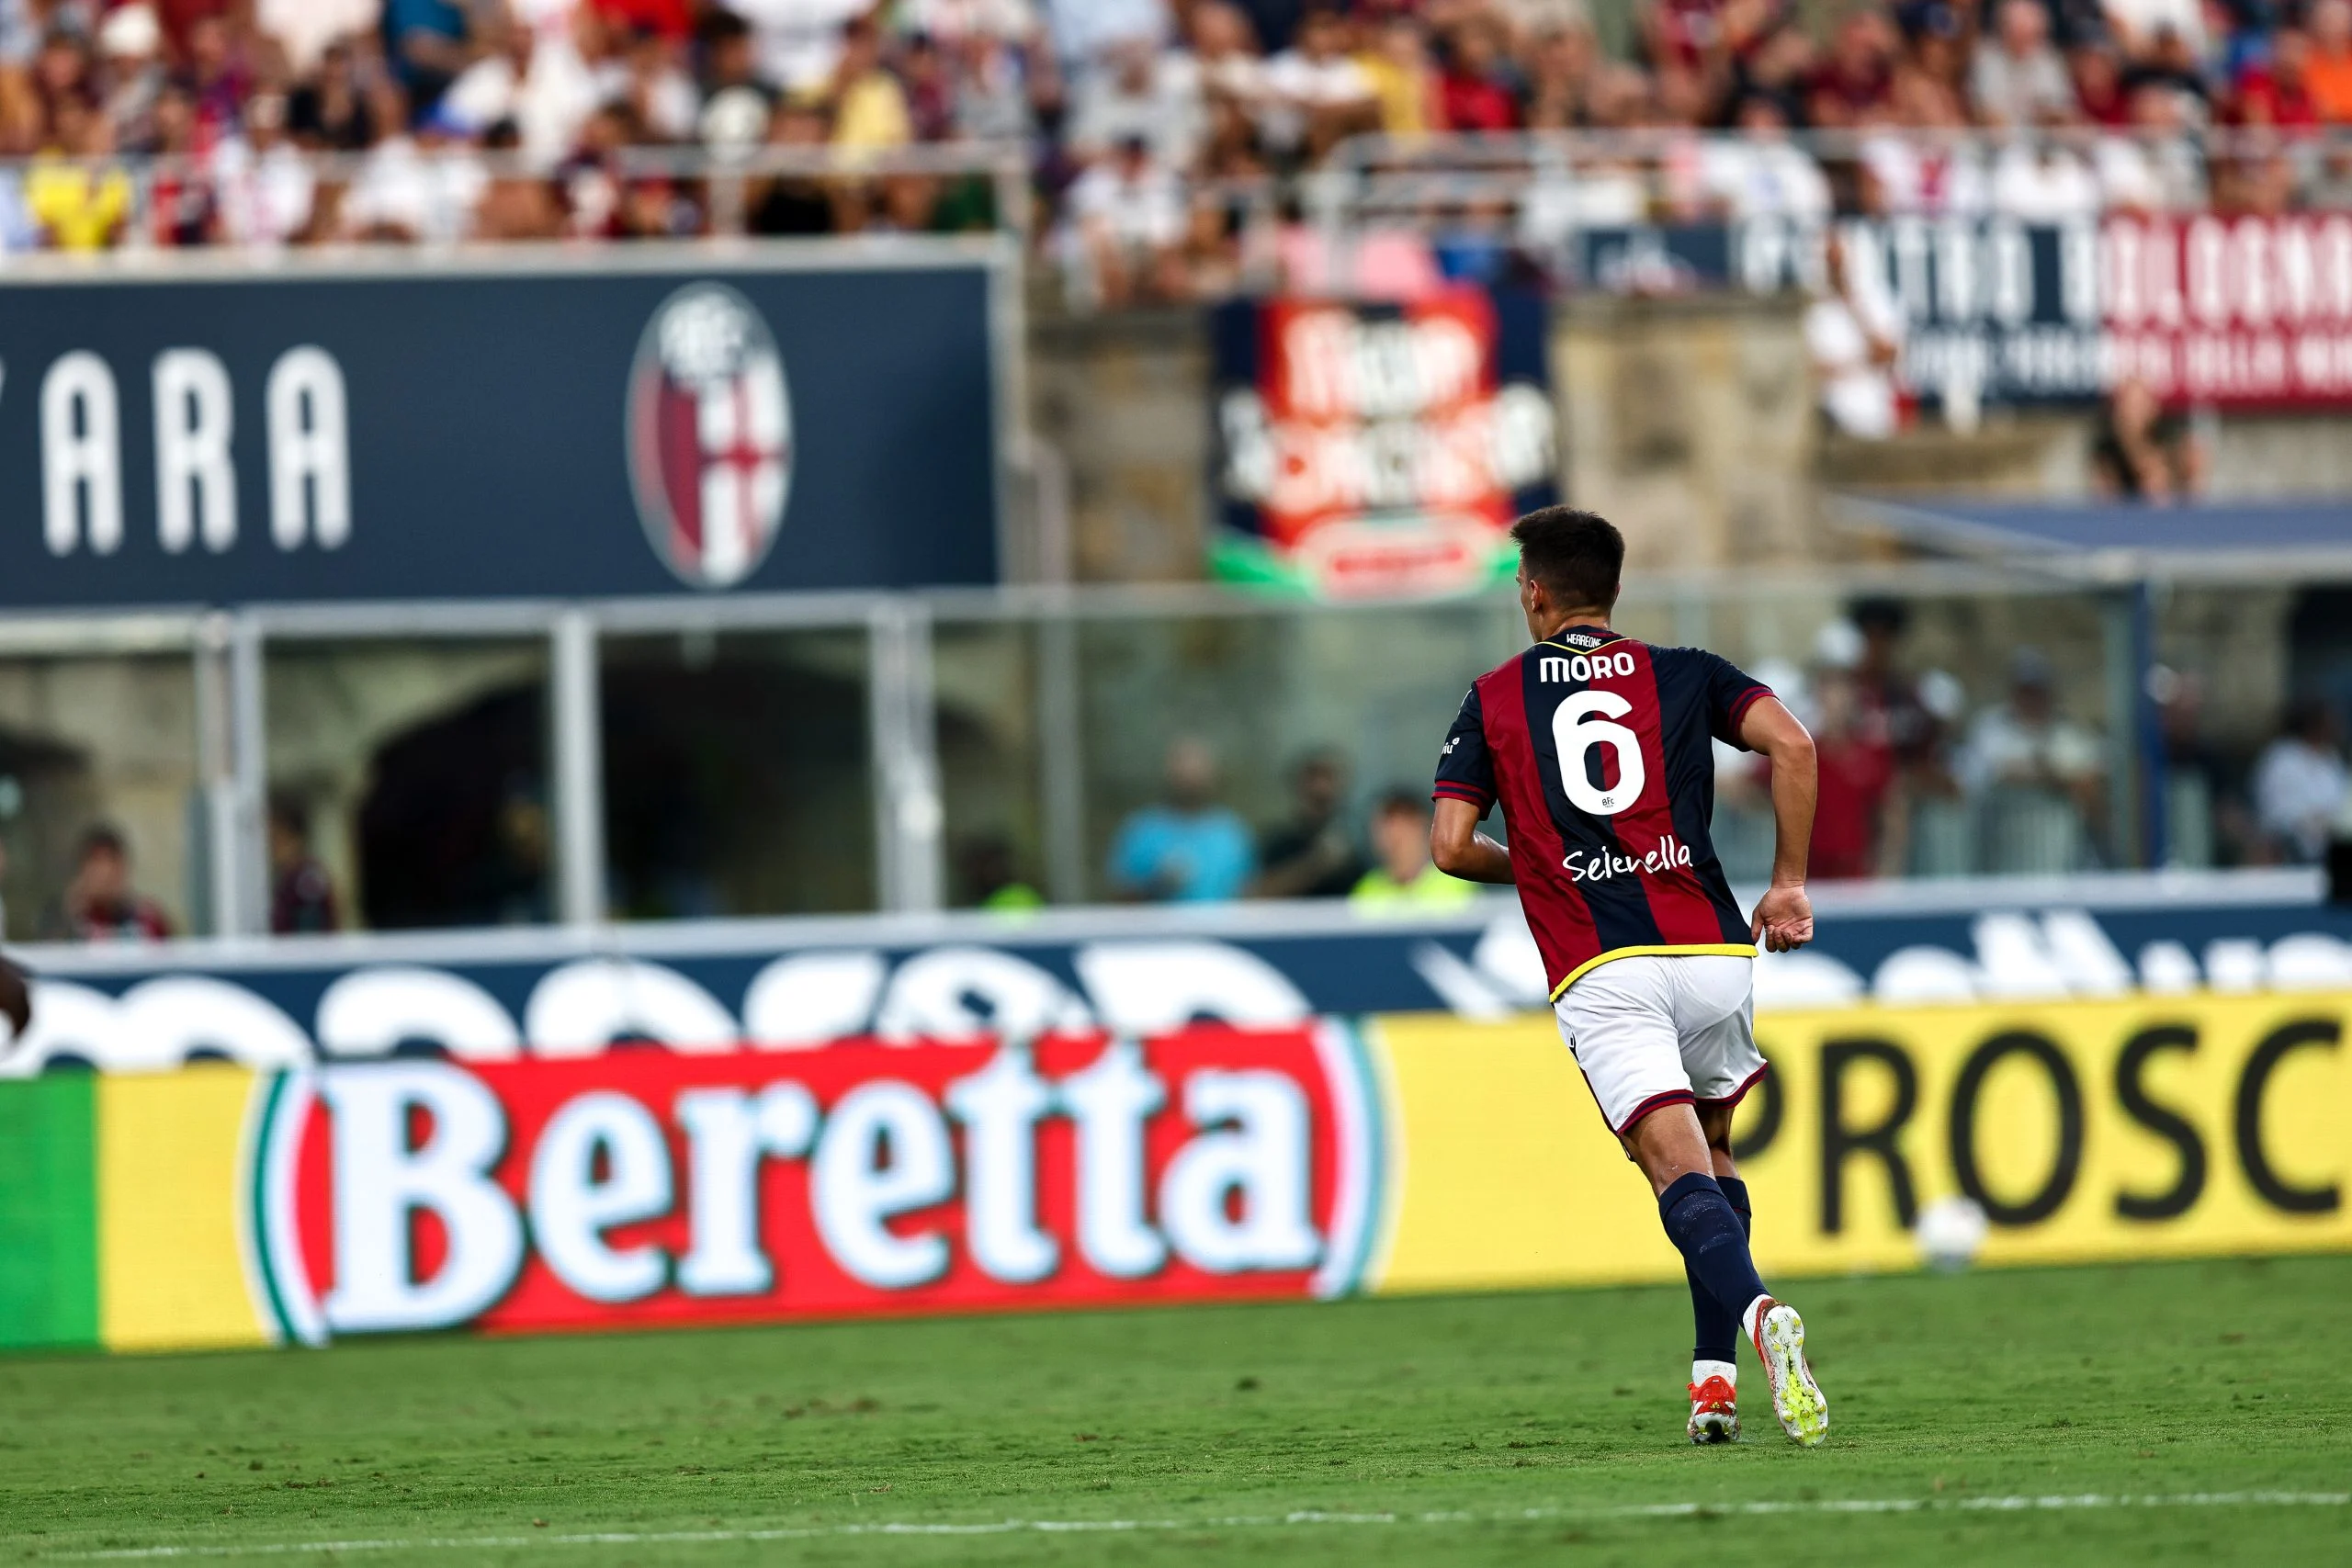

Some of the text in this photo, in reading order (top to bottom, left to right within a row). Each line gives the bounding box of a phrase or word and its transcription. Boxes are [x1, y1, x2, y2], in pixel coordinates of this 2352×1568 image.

[0, 344, 353, 555] ARA
[1540, 652, 1635, 682] MORO
[1552, 690, 1645, 816] 6
[1562, 835, 1693, 882] Selenella
[322, 1043, 1326, 1333] Beretta
